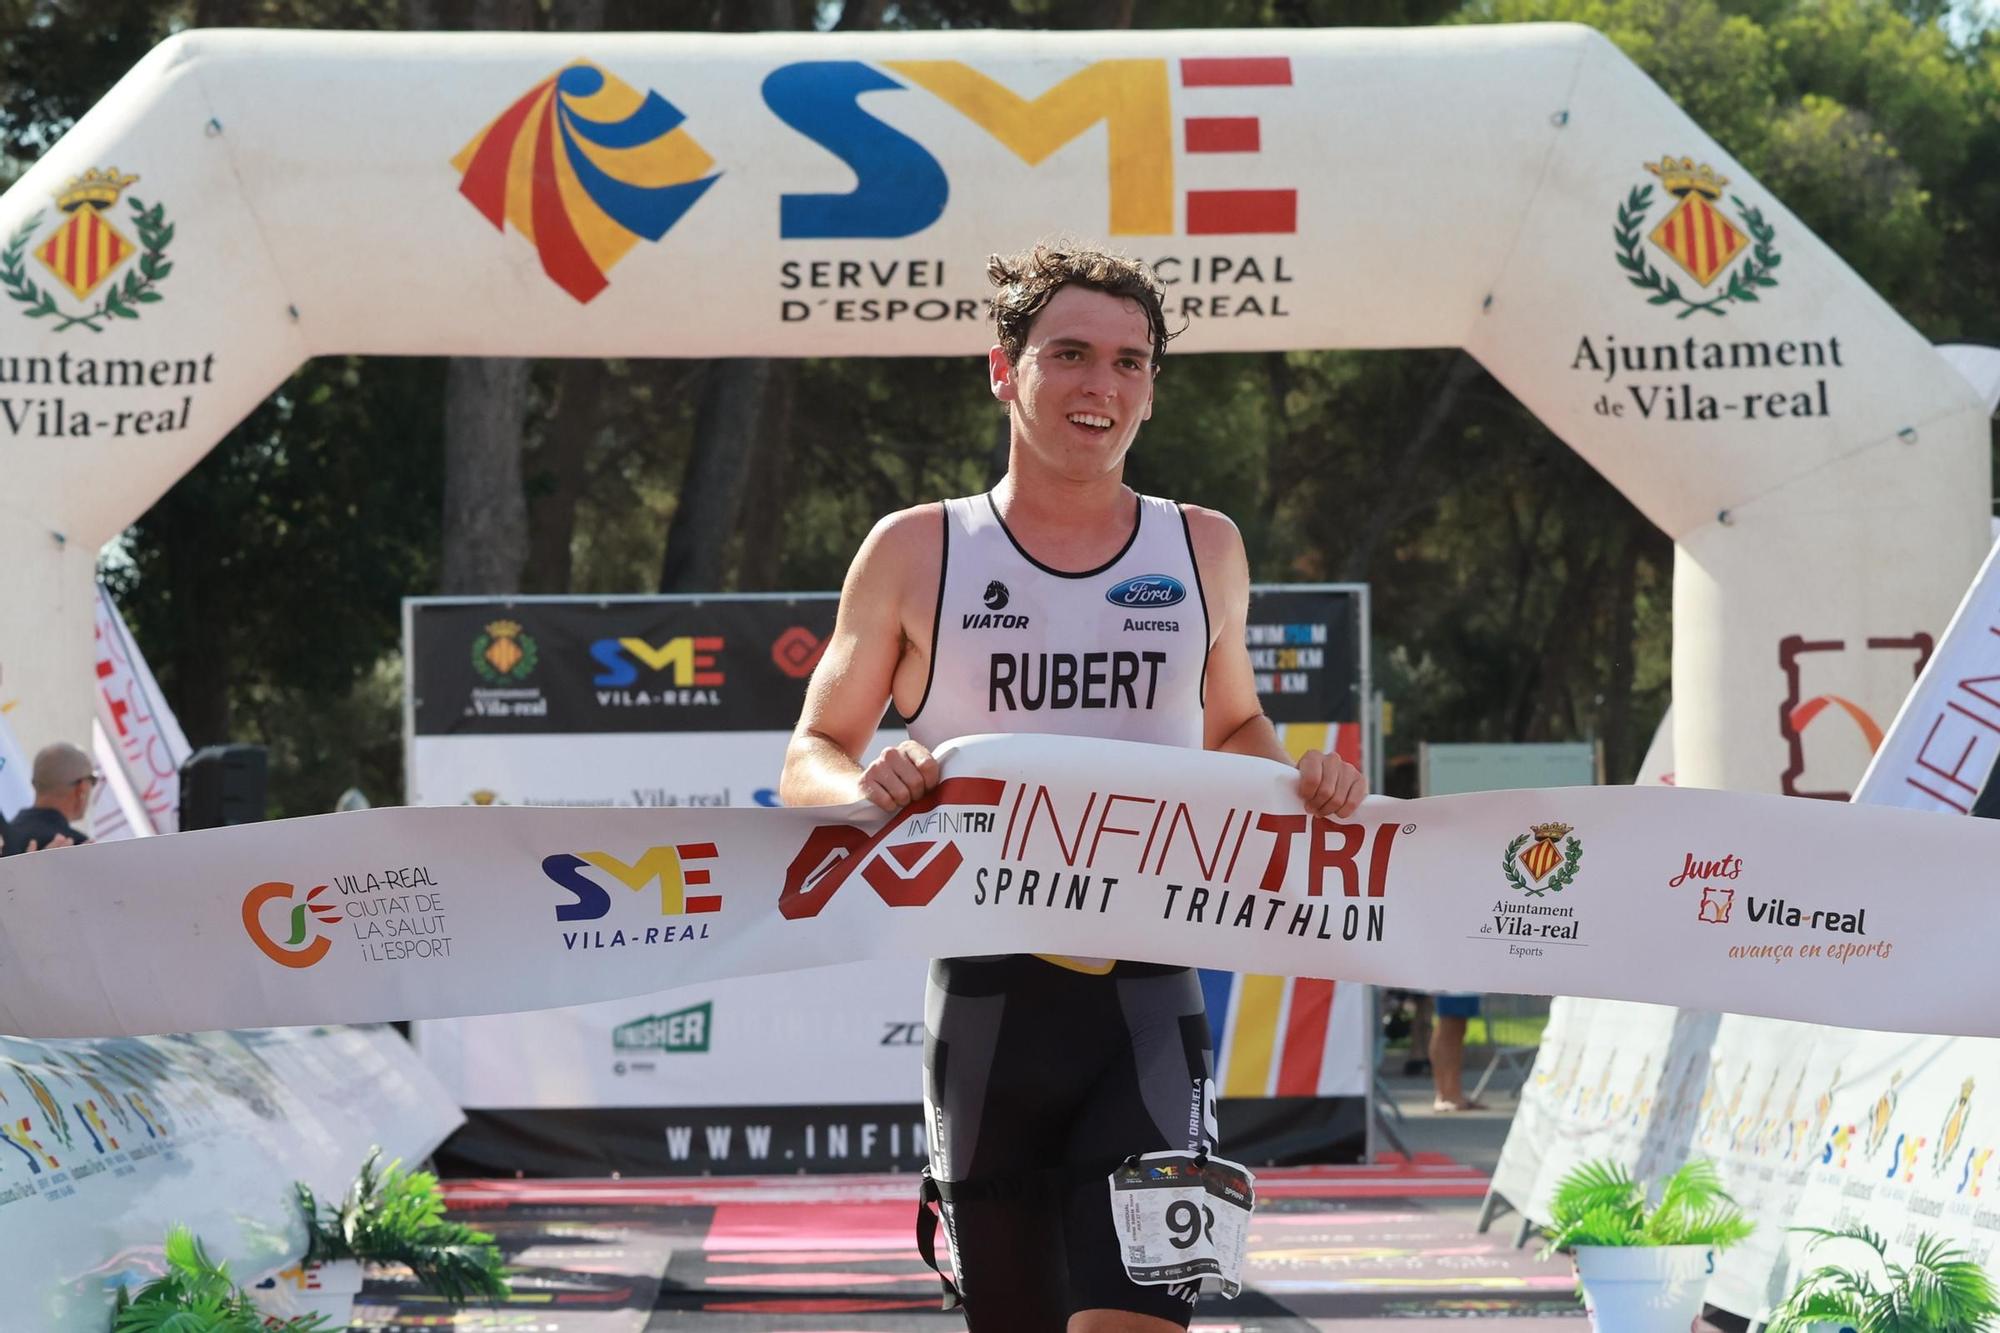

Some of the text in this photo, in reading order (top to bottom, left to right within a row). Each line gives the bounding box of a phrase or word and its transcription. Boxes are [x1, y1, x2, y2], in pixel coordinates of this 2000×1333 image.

[762, 57, 1298, 238] SME
[781, 256, 1294, 289] SERVEI CIPAL
[1163, 295, 1290, 318] -REAL
[0, 351, 214, 387] untament
[1571, 336, 1843, 382] Ajuntament
[1594, 380, 1830, 420] de Vila-real
[0, 396, 192, 437] Vila-real
[1124, 580, 1173, 602] Ford
[962, 614, 1029, 630] VIATOR
[1123, 618, 1179, 632] Aucresa
[589, 637, 725, 687] SME
[989, 651, 1167, 712] RUBERT
[474, 699, 547, 716] Vila-real
[596, 691, 721, 706] VILA-REAL
[632, 789, 731, 807] Vila-real
[907, 812, 996, 838] INFINITRI
[334, 867, 438, 895] VILA-REAL
[542, 842, 723, 921] SME
[1669, 853, 1743, 888] Junts
[345, 894, 445, 918] CIUTAT DE
[974, 867, 1385, 941] SPRINT TRIATHLON
[1493, 900, 1574, 917] Ajuntament
[1747, 897, 1866, 935] Vila-real
[353, 915, 445, 940] LA SALUT
[563, 924, 709, 949] VILA-REAL
[1480, 916, 1579, 940] de Vila-real
[370, 938, 452, 961] L'ESPORT
[1509, 944, 1544, 958] Esports
[1728, 941, 1893, 965] avança en esports
[1189, 1078, 1201, 1136] ORIHUELA
